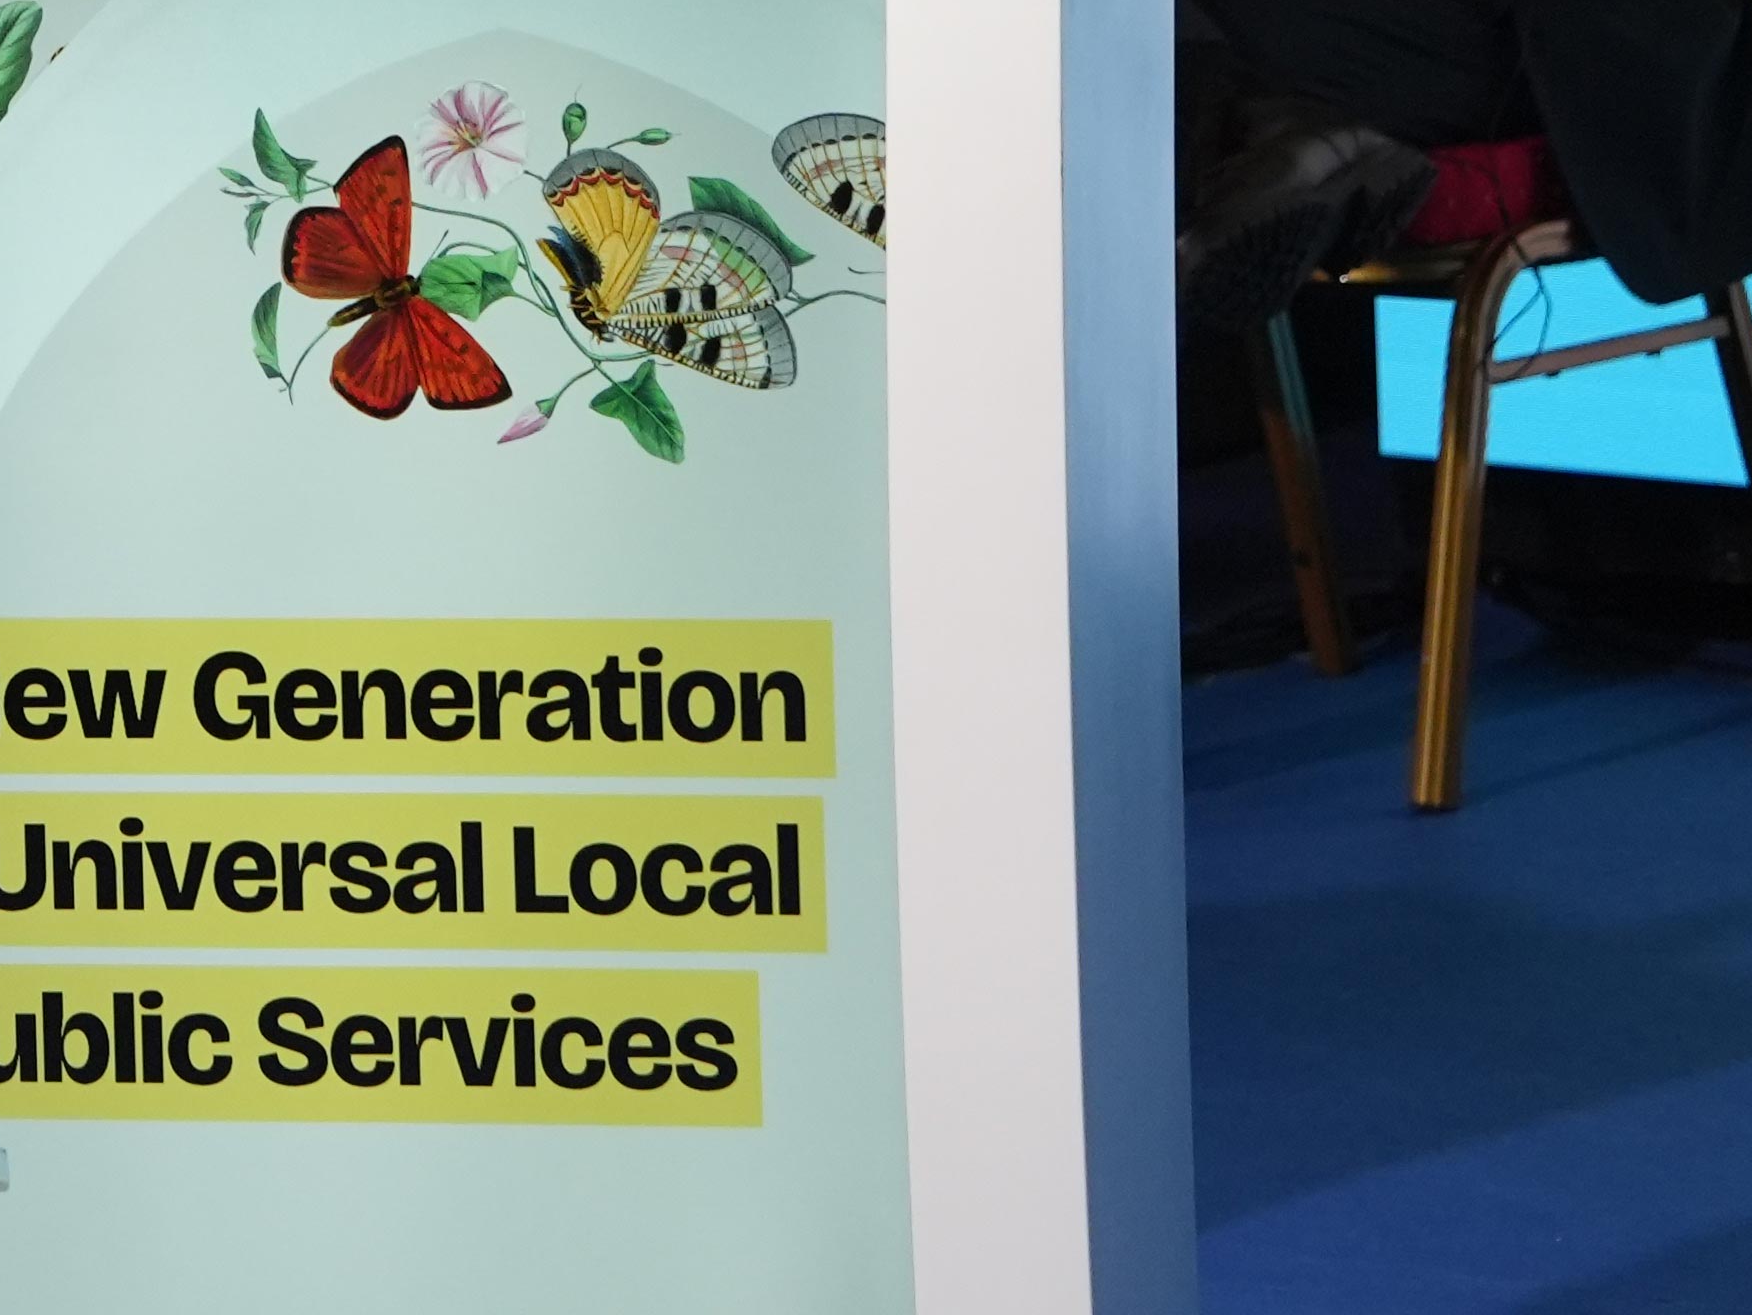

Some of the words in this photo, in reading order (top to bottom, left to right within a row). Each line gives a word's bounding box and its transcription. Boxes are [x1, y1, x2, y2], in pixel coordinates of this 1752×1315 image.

[192, 646, 808, 744] Generation
[511, 823, 801, 918] Local
[257, 992, 739, 1091] Services
